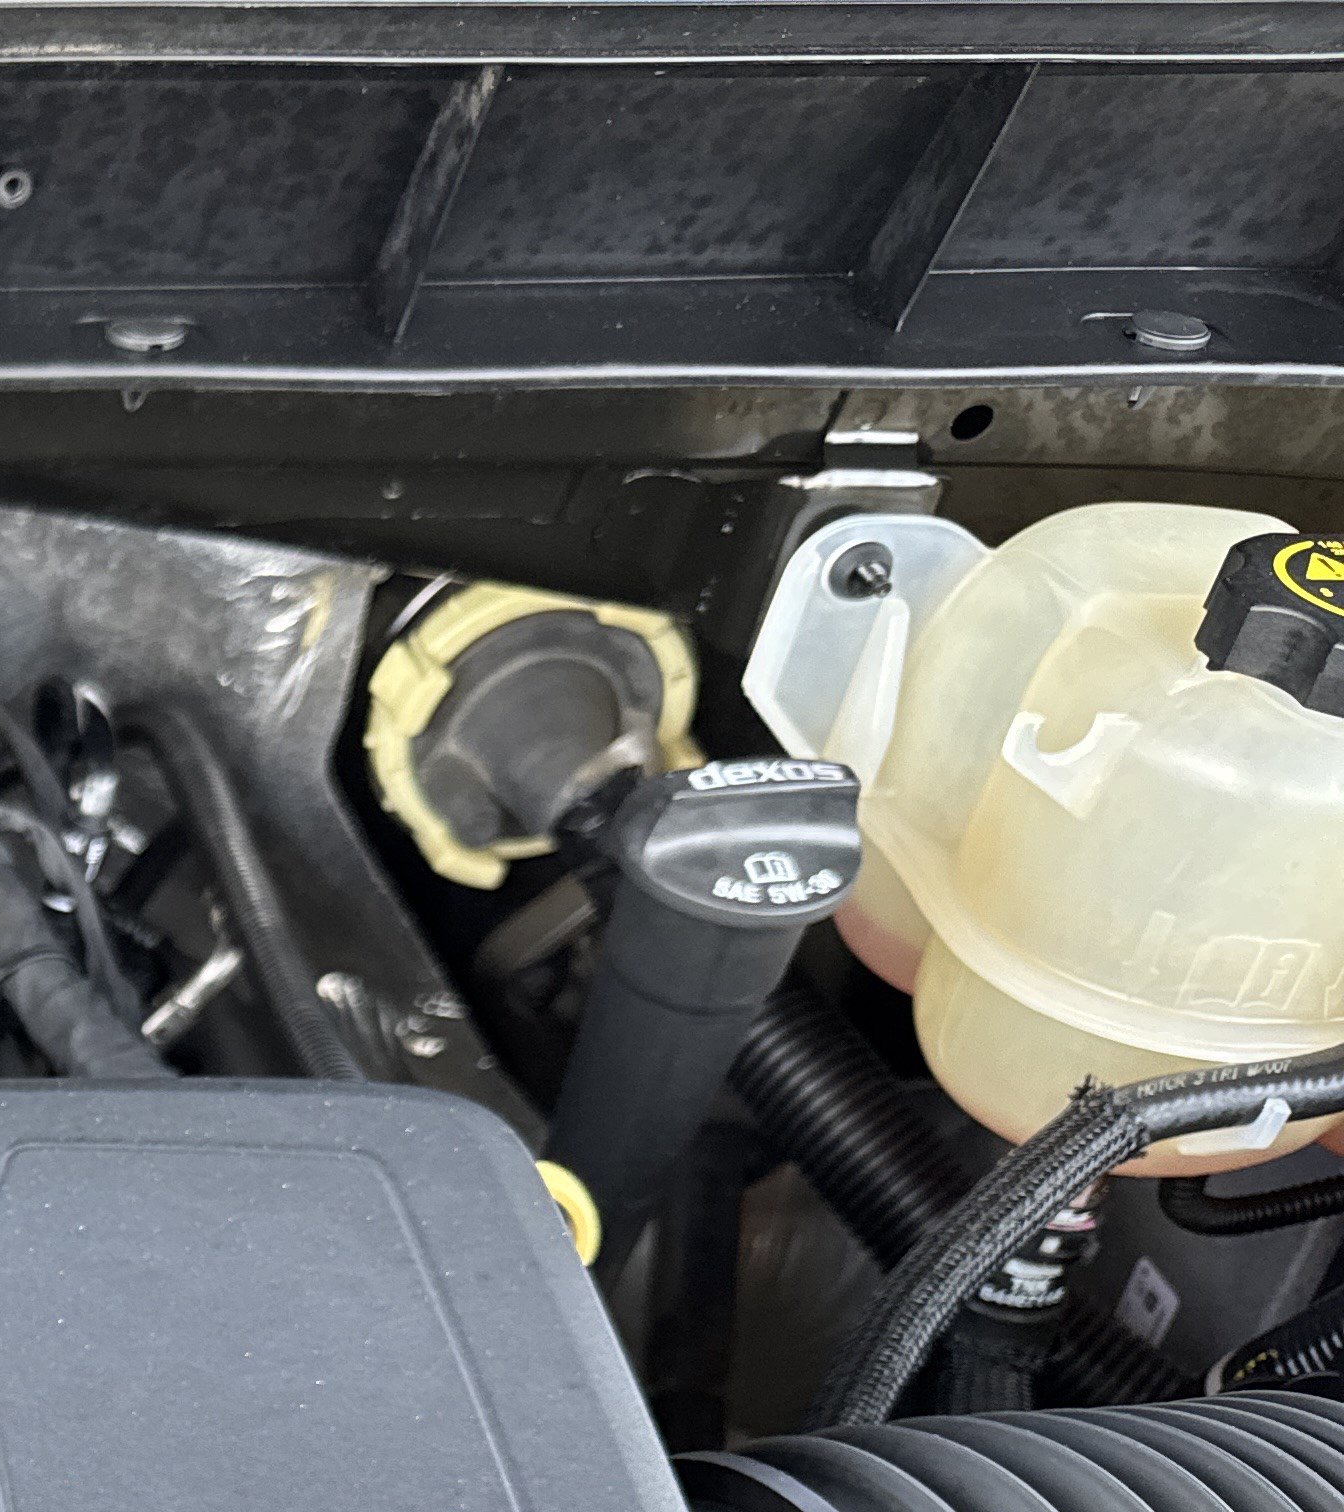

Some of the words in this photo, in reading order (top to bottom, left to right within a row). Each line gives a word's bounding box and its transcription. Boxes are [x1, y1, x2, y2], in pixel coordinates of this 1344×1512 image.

[687, 760, 845, 791] dexos
[712, 875, 763, 904] SAE
[767, 868, 844, 905] 5W-30
